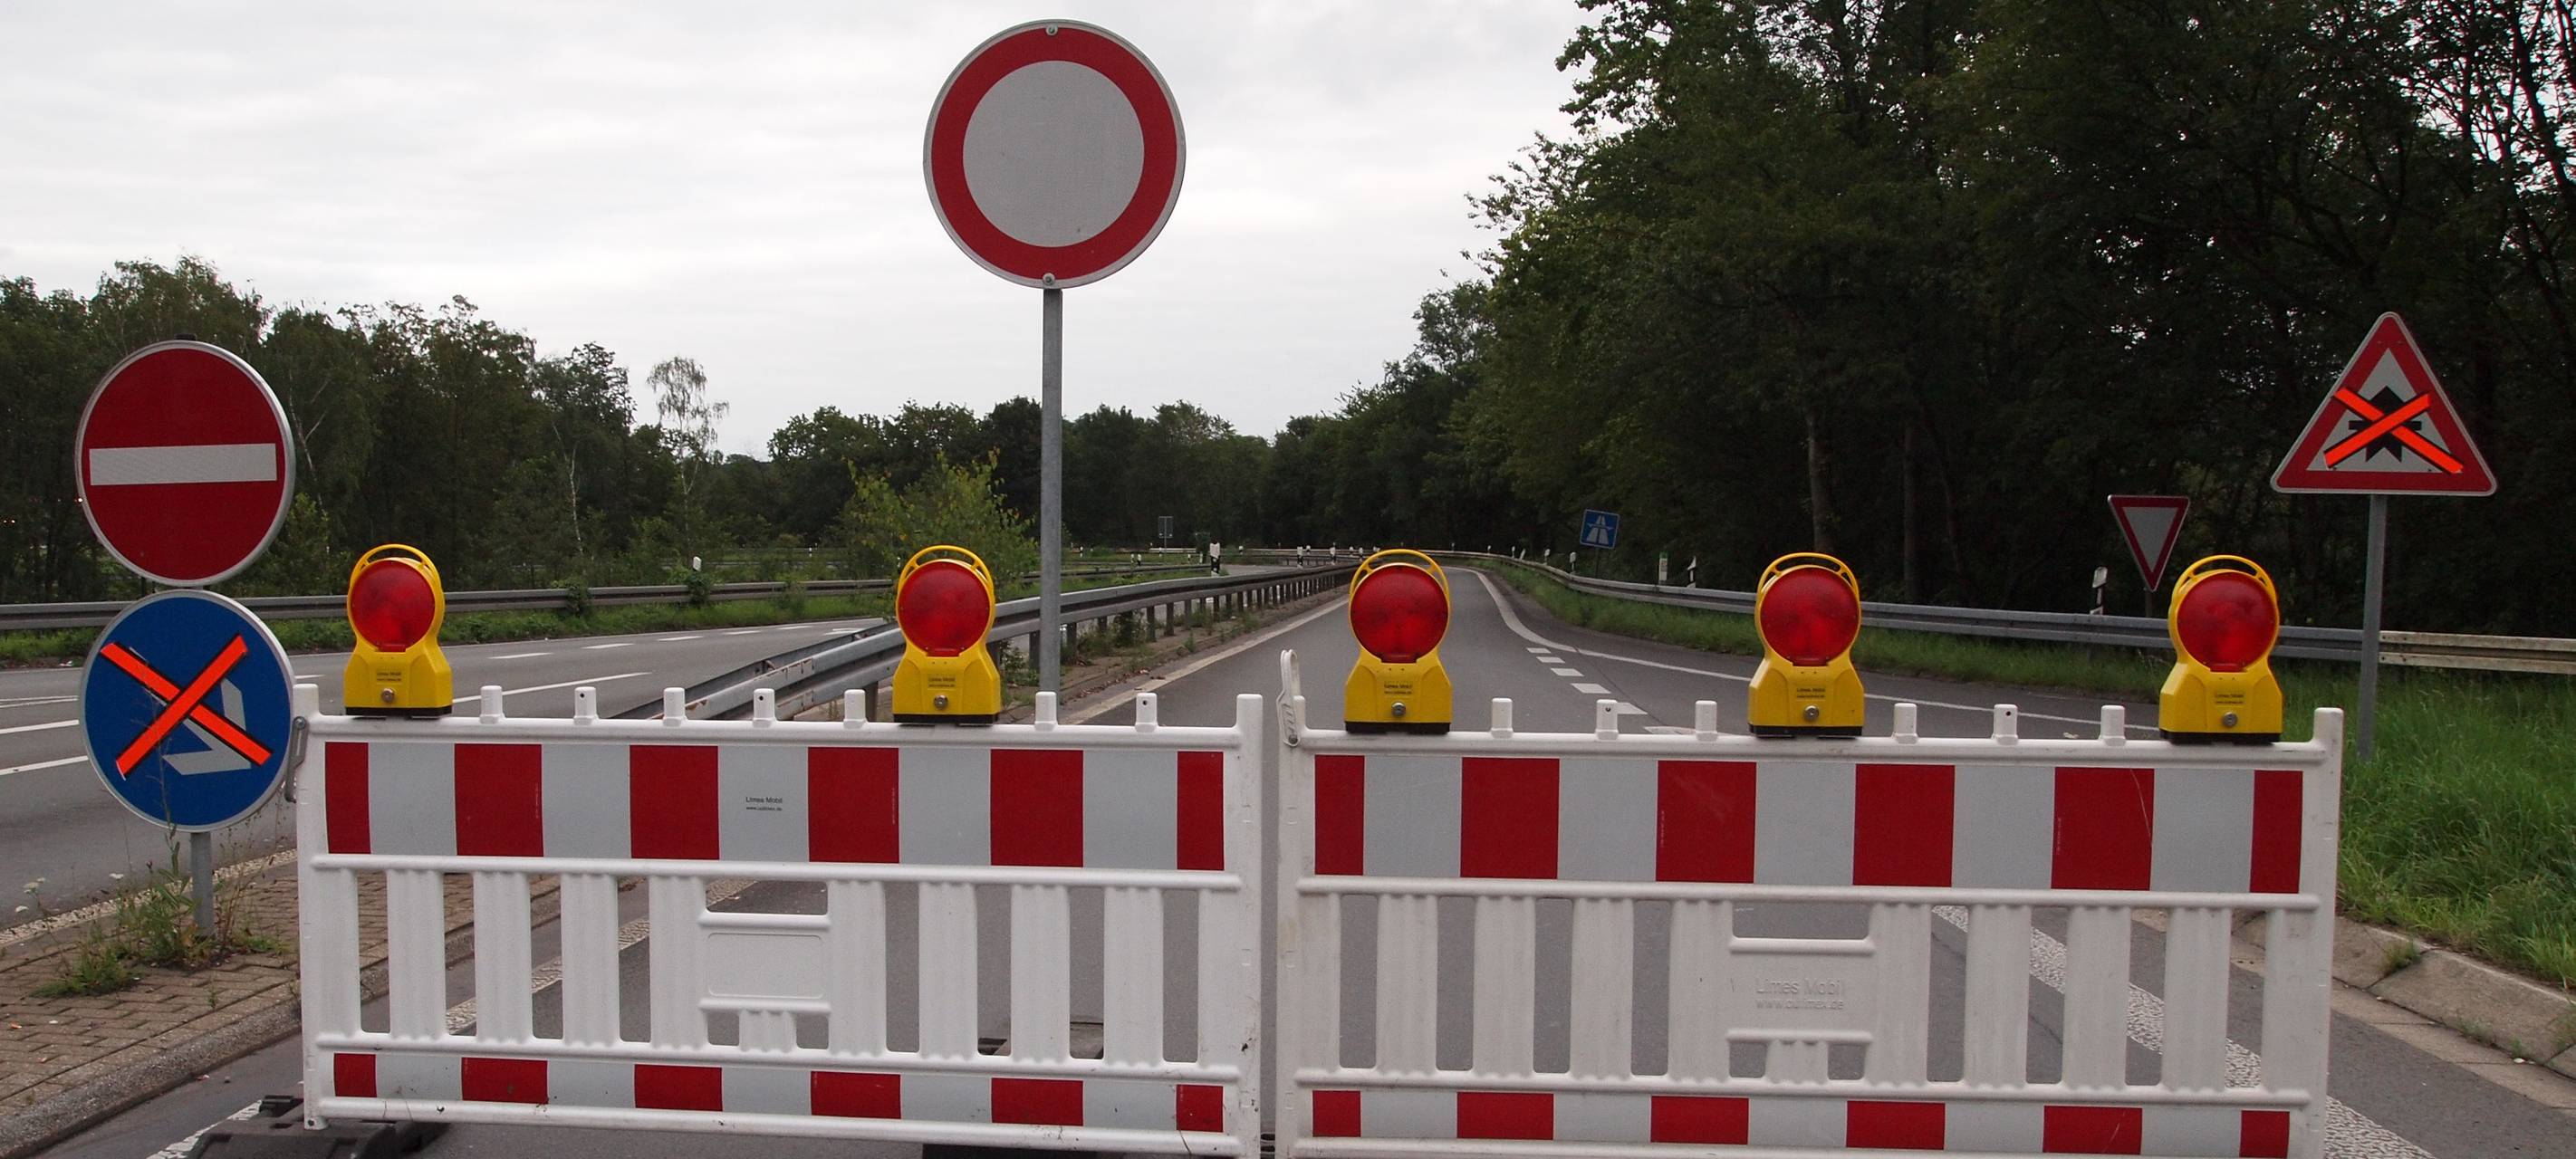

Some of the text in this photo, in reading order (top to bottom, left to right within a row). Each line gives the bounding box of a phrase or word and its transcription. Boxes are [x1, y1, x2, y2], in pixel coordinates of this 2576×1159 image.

[765, 796, 783, 804] Mobil
[1755, 977, 1846, 995] Limes Mobil
